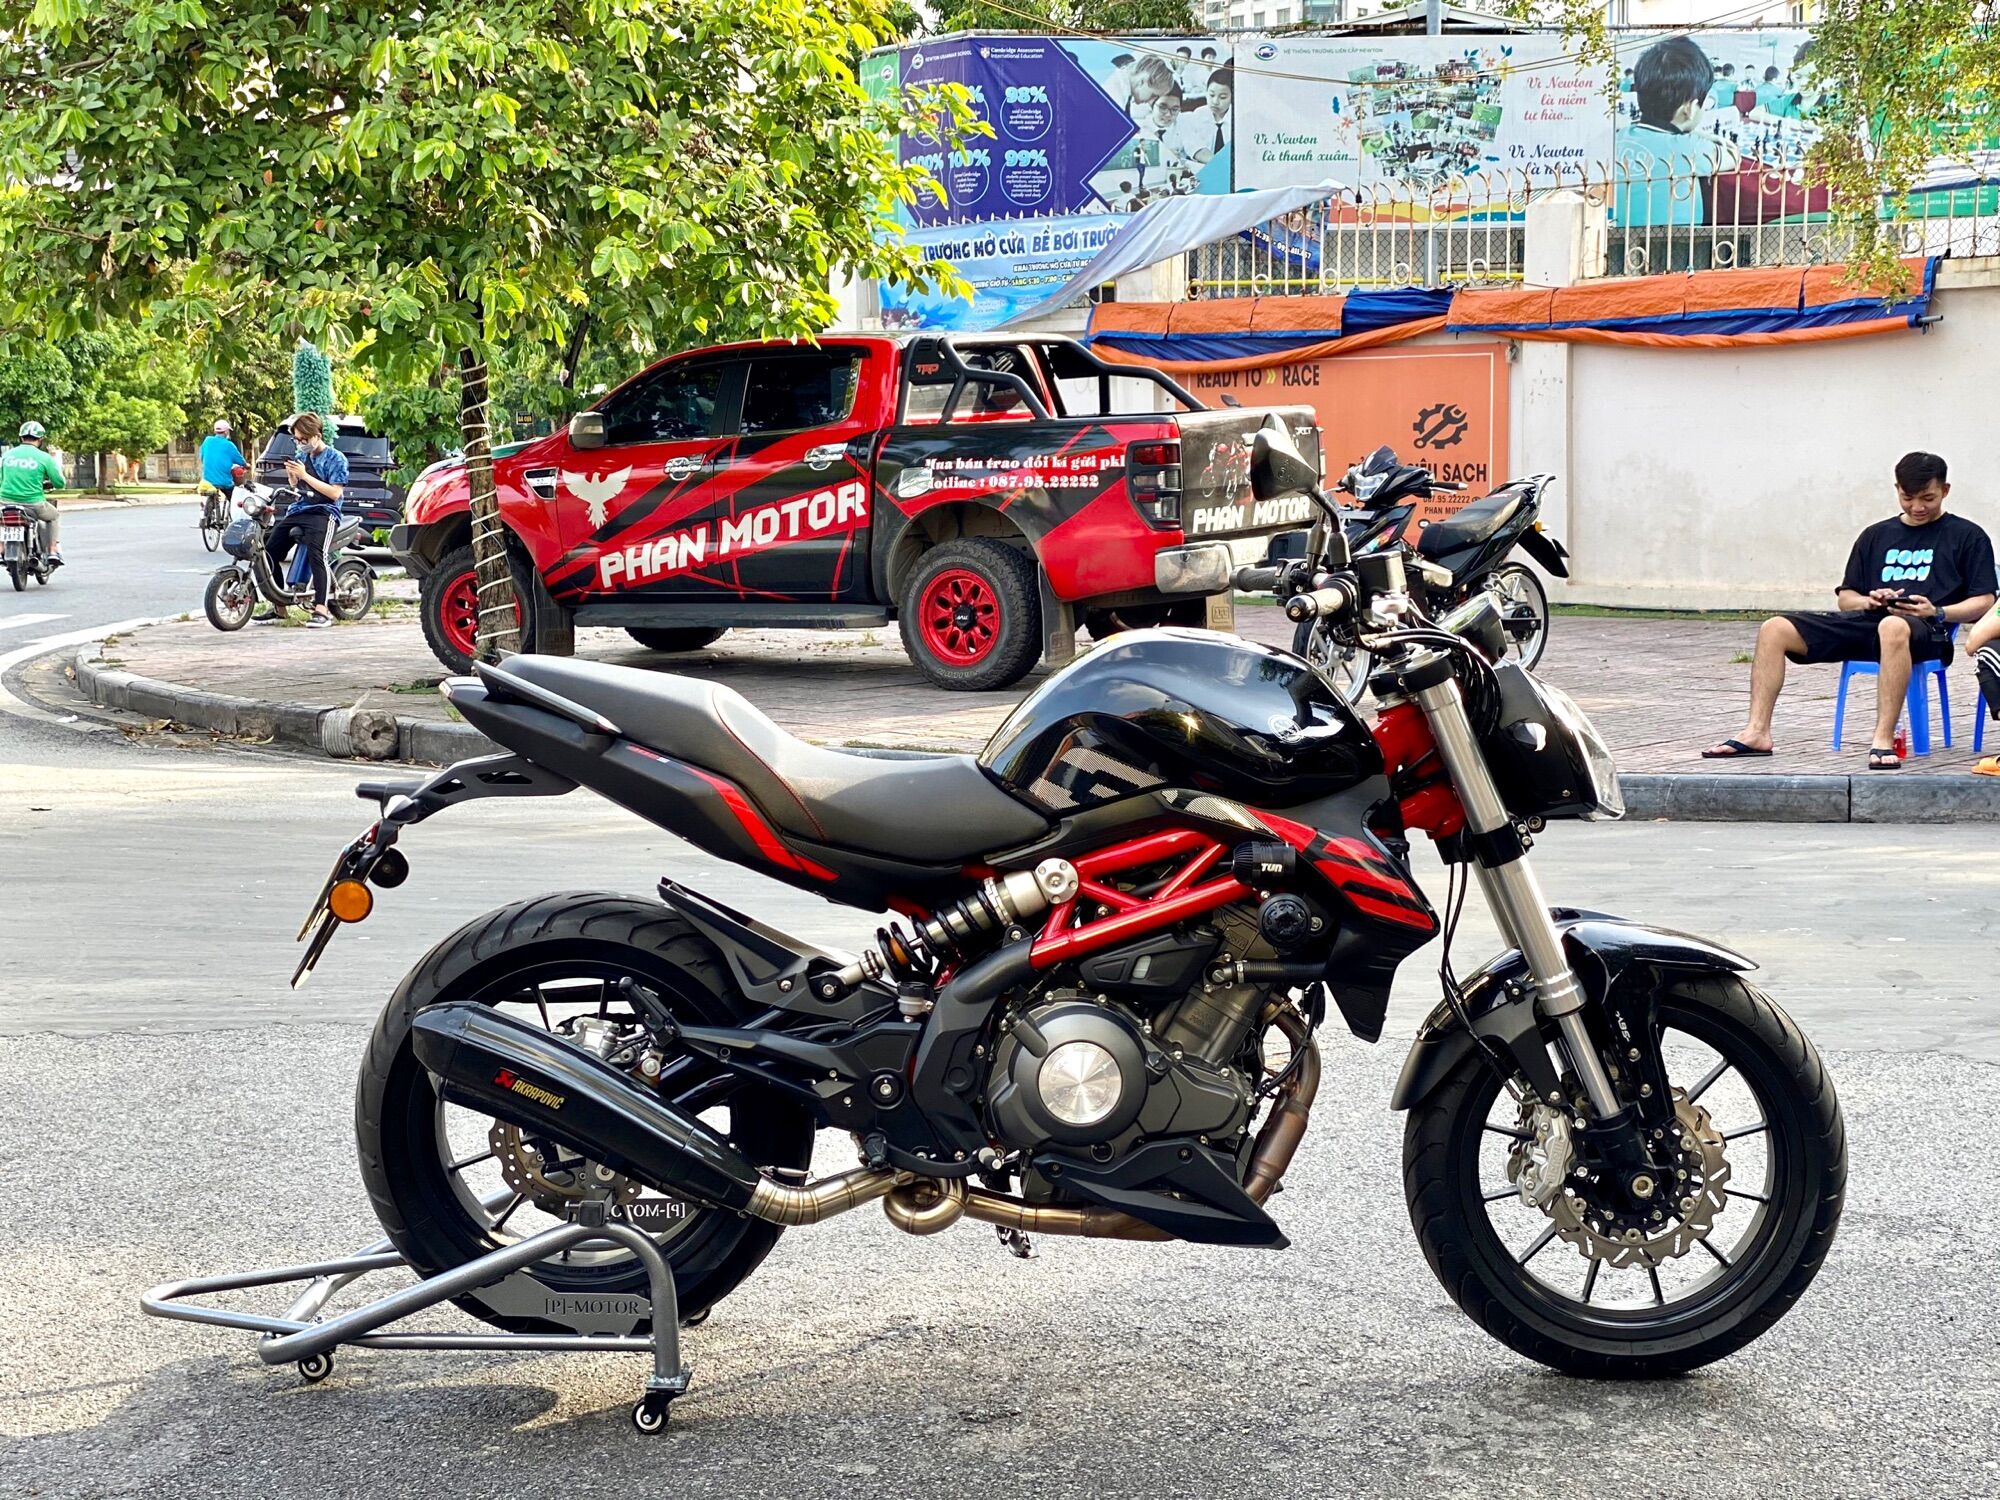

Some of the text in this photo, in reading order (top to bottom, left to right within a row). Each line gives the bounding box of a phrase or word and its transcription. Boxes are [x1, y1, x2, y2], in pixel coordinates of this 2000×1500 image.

[1545, 76, 1594, 89] Newton
[1005, 85, 1047, 104] 98%
[1271, 133, 1318, 145] Newton
[1004, 149, 1048, 167] 99%
[1279, 150, 1313, 161] thanh
[1529, 144, 1585, 158] Newton
[973, 232, 996, 258] MỞ
[1053, 230, 1079, 251] BƠI
[1082, 222, 1119, 248] TRƯỜ
[1197, 365, 1320, 388] READY TO RACE
[4, 455, 38, 470] Grab
[955, 457, 983, 469] bán
[986, 457, 1020, 469] trao
[988, 474, 1099, 488] 087.95.22222
[1192, 495, 1310, 533] PHAN MOTOR
[1424, 506, 1443, 514] PHAN
[599, 481, 866, 588] PHAN MOTOR
